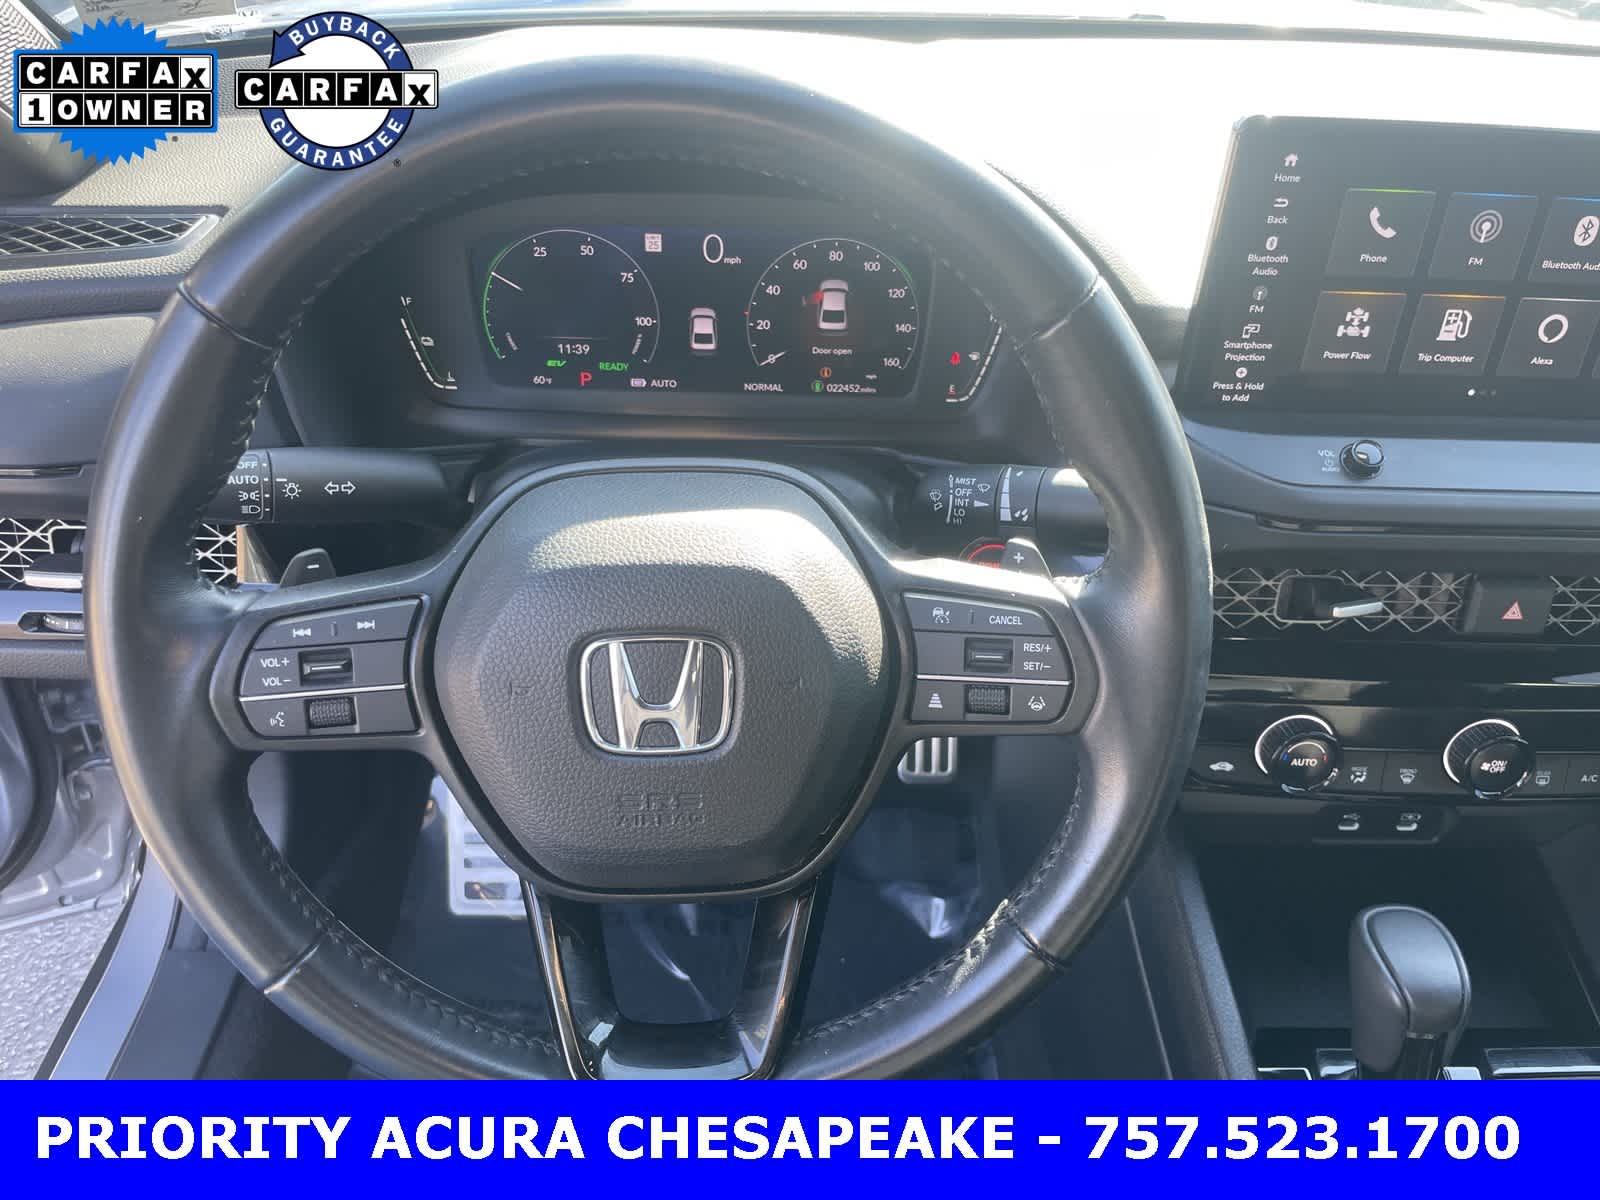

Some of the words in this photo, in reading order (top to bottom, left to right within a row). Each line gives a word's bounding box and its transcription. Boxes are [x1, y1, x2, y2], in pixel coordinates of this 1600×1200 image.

[1274, 173, 1301, 183] Home
[1267, 215, 1289, 224] Back
[533, 247, 547, 257] 25
[580, 245, 594, 256] 50
[703, 233, 724, 263] 0
[724, 256, 742, 265] mph
[829, 250, 844, 262] 80
[1247, 254, 1289, 263] Bluetooth
[1359, 253, 1388, 263] Phone
[1468, 256, 1484, 266] FM
[793, 259, 808, 270] 60
[863, 260, 881, 272] 100
[1542, 260, 1581, 270] Bluetooth
[1251, 267, 1279, 277] Audio
[621, 272, 634, 283] 75
[766, 284, 781, 296] 40
[888, 288, 905, 299] 120
[1249, 305, 1265, 313] FM
[635, 316, 652, 327] 100
[756, 319, 771, 330] 20
[895, 323, 912, 334] 140
[558, 343, 590, 355] 11:39
[1223, 340, 1273, 350] Smartphone
[812, 346, 832, 355] Door
[833, 348, 853, 356] open
[1323, 350, 1349, 360] Power
[1350, 351, 1371, 361] Flow
[883, 357, 900, 367] 160
[1224, 353, 1266, 362] Projection
[1417, 353, 1433, 363] Trip
[1433, 353, 1475, 364] Computer
[1530, 356, 1554, 366] Alexa
[599, 362, 629, 371] READY
[579, 372, 592, 386] P
[650, 379, 678, 388] AUTO
[744, 382, 784, 392] NORMAL
[826, 383, 860, 393] 022452
[1212, 381, 1234, 391] Press
[1235, 382, 1242, 390] &
[1244, 382, 1265, 391] Hold
[1222, 394, 1231, 402] to
[1231, 394, 1250, 402] Add
[227, 475, 259, 485] AUTO
[955, 477, 977, 486] MIST
[954, 487, 972, 496] OFF
[954, 498, 969, 507] INT
[953, 508, 966, 517] LO
[989, 615, 1023, 625] CANCEL
[1290, 758, 1318, 767] AUTO
[1581, 774, 1599, 783] A/C
